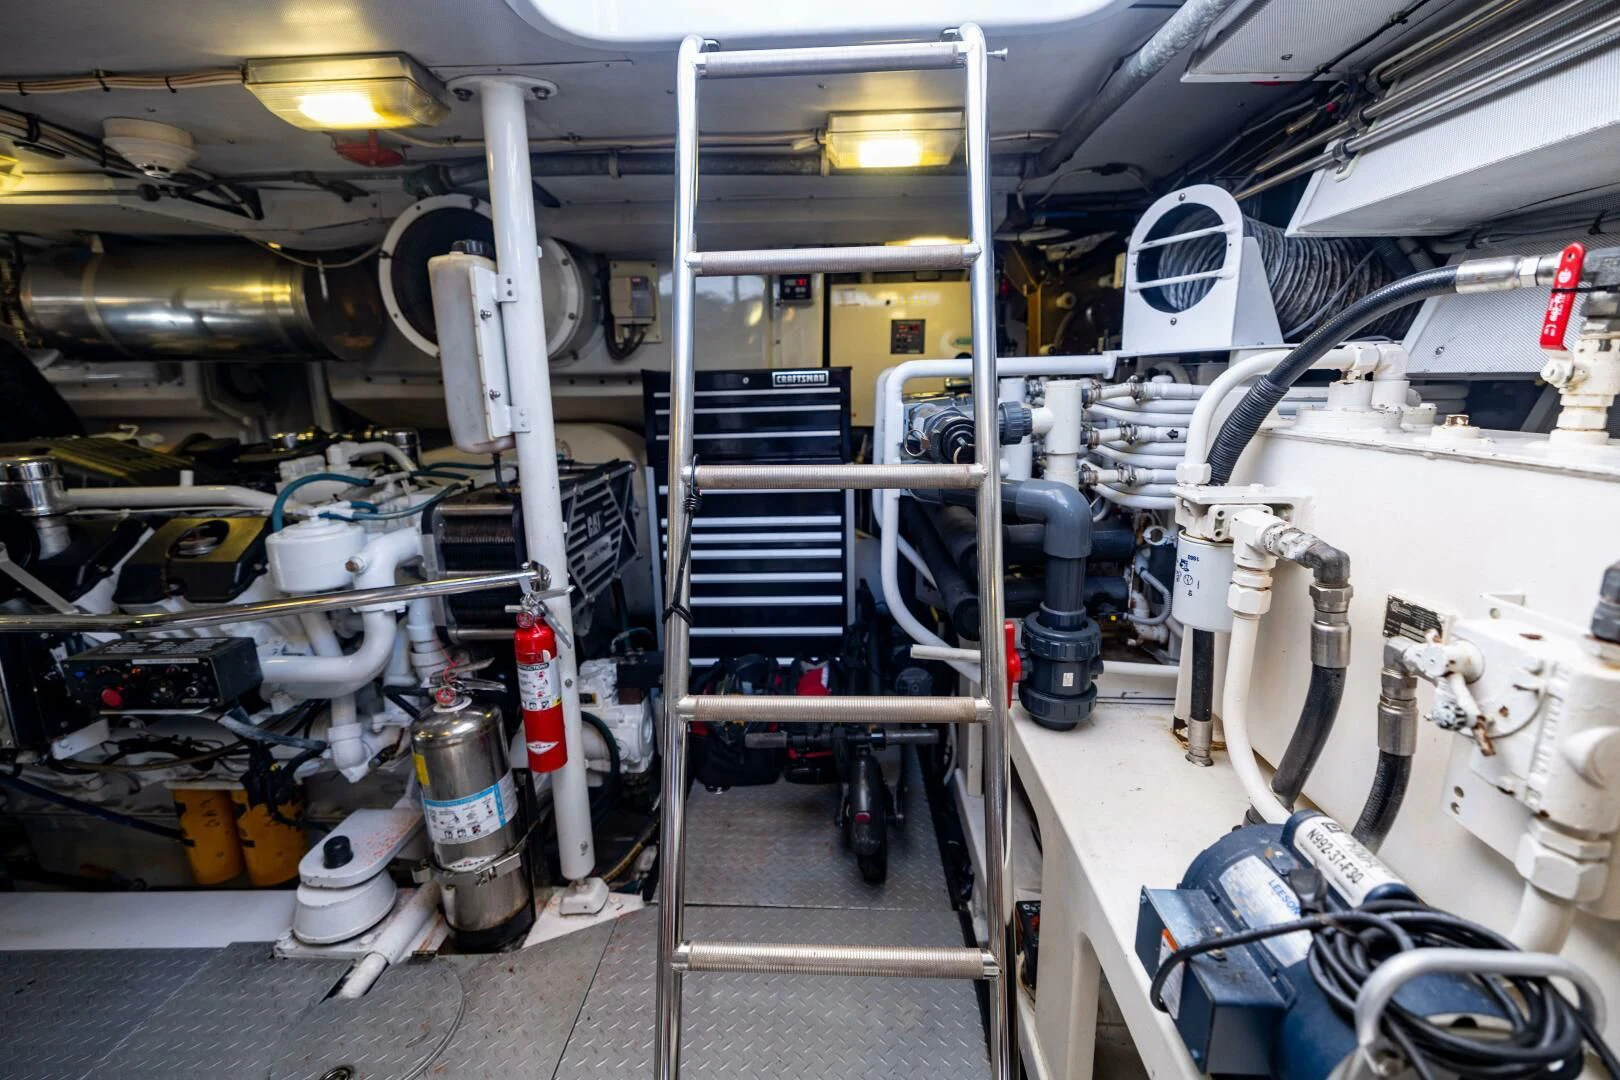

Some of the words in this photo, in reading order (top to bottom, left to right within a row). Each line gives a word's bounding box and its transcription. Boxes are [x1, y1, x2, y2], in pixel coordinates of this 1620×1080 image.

[776, 374, 825, 383] CRAFTSMAN
[587, 511, 602, 538] CAT
[1269, 879, 1301, 915] LEESON
